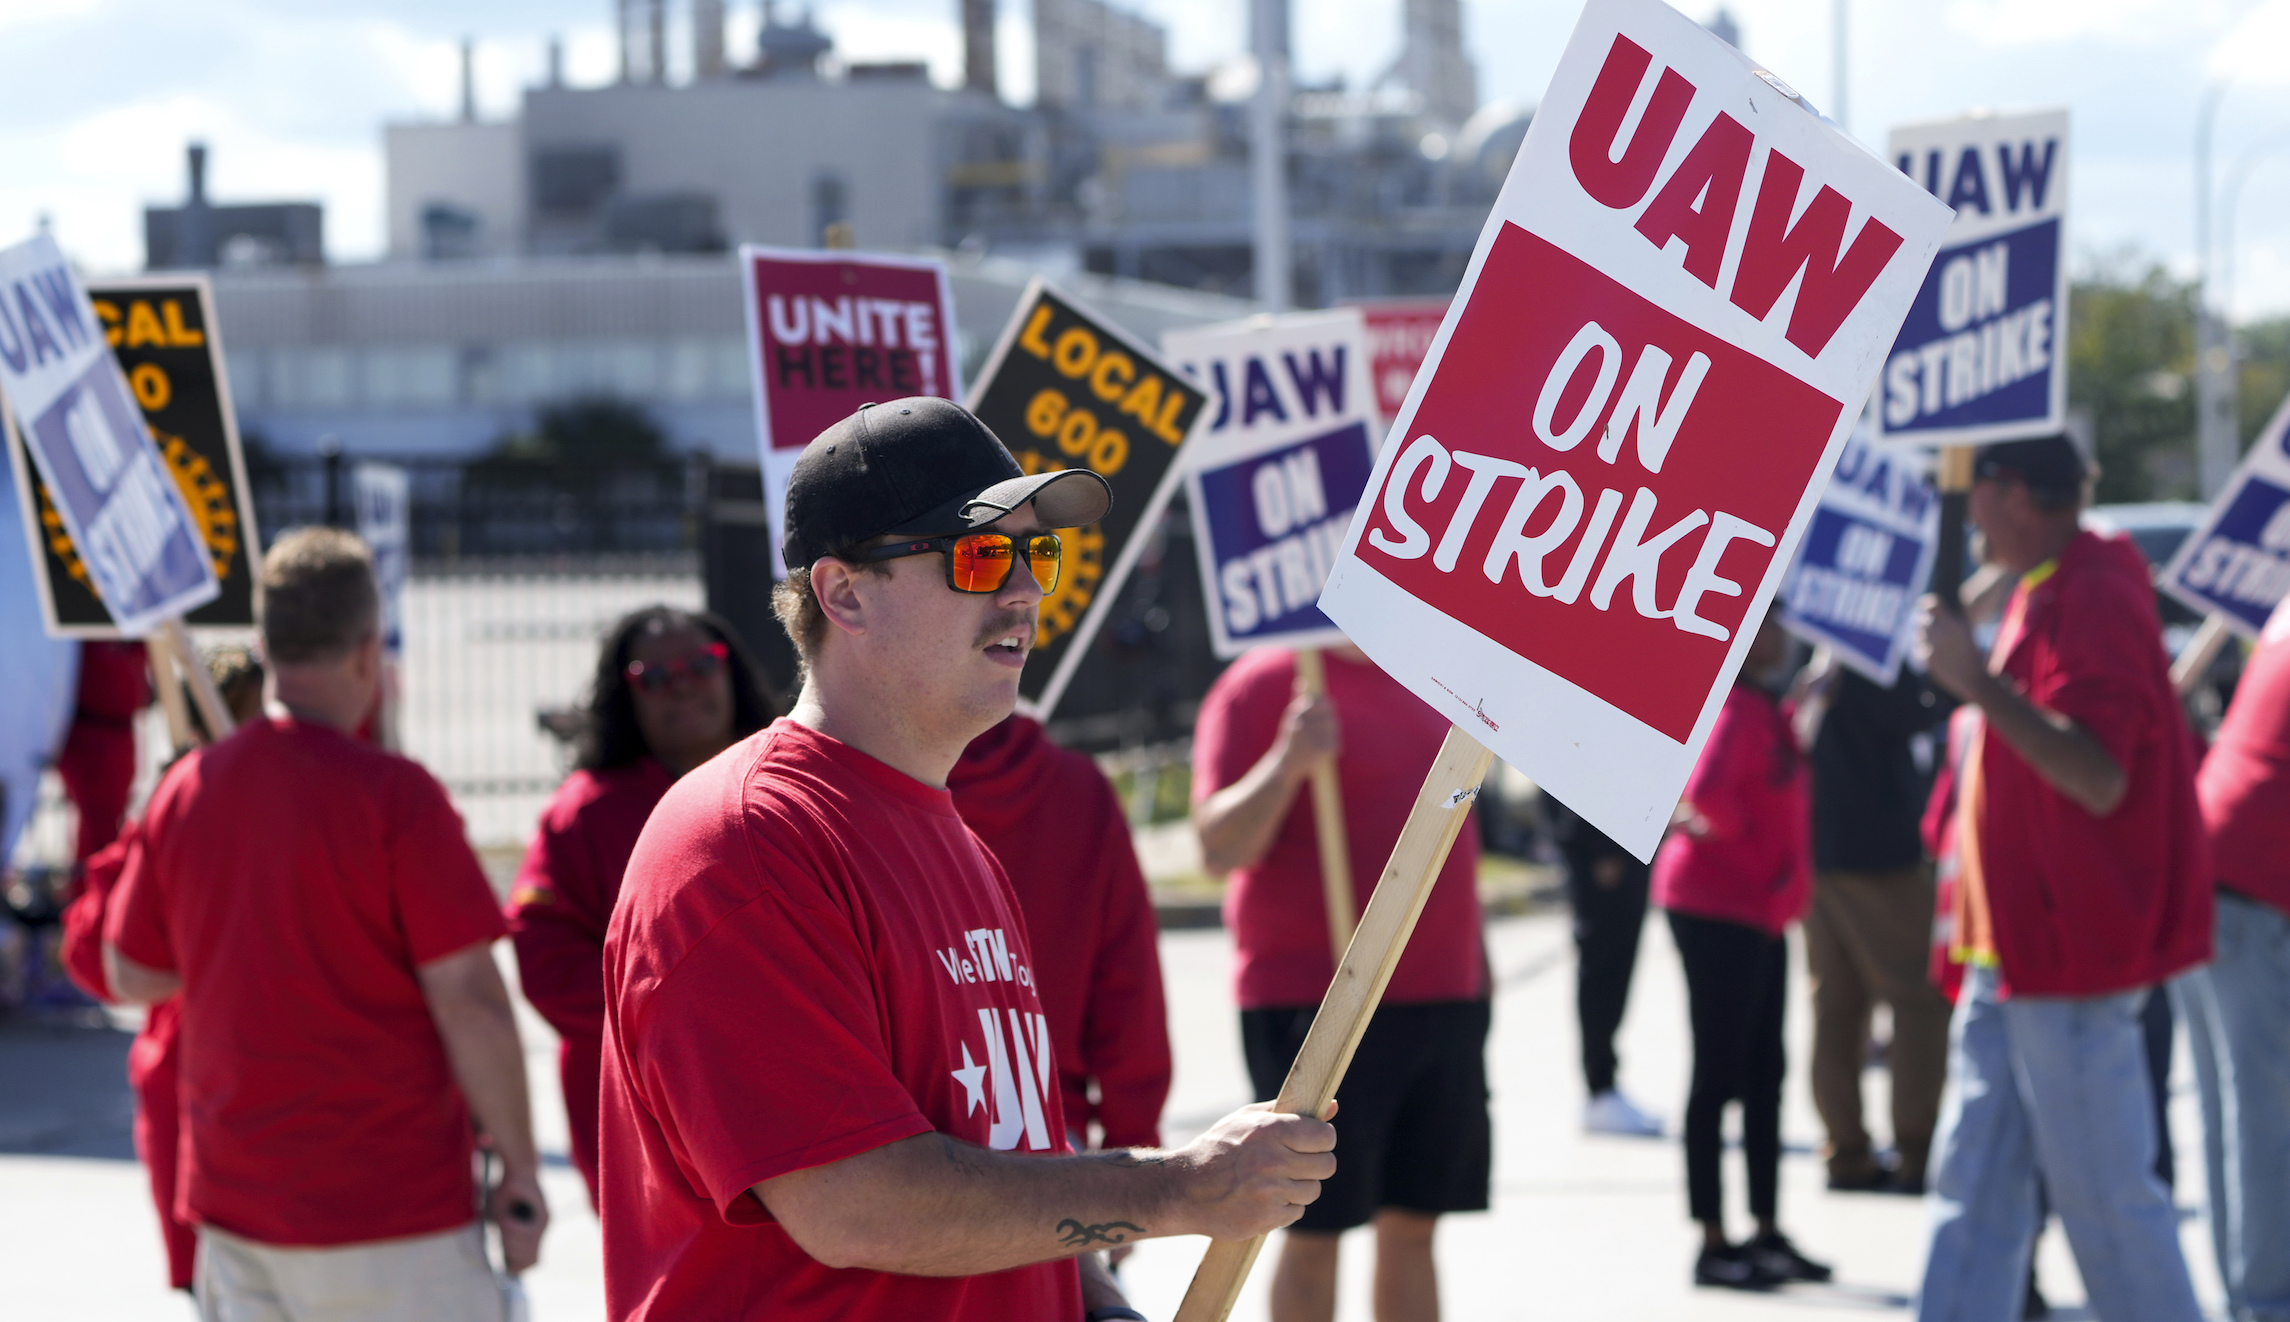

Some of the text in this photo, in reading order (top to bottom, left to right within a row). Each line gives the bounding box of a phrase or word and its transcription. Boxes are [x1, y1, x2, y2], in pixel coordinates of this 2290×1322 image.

[1568, 32, 1905, 360] UAW
[0, 264, 92, 379] UAW
[92, 298, 204, 349] CAL
[768, 296, 937, 348] UNITE
[1938, 241, 2009, 334] ON
[1018, 304, 1188, 447] LOCAL
[1531, 320, 1713, 475] ON
[1885, 297, 2050, 427] STRIKE
[1024, 388, 1130, 478] 600
[1251, 446, 1328, 539] ON
[1368, 433, 1775, 643] STRIKE
[1220, 503, 1357, 633] STRI
[936, 946, 976, 985] We
